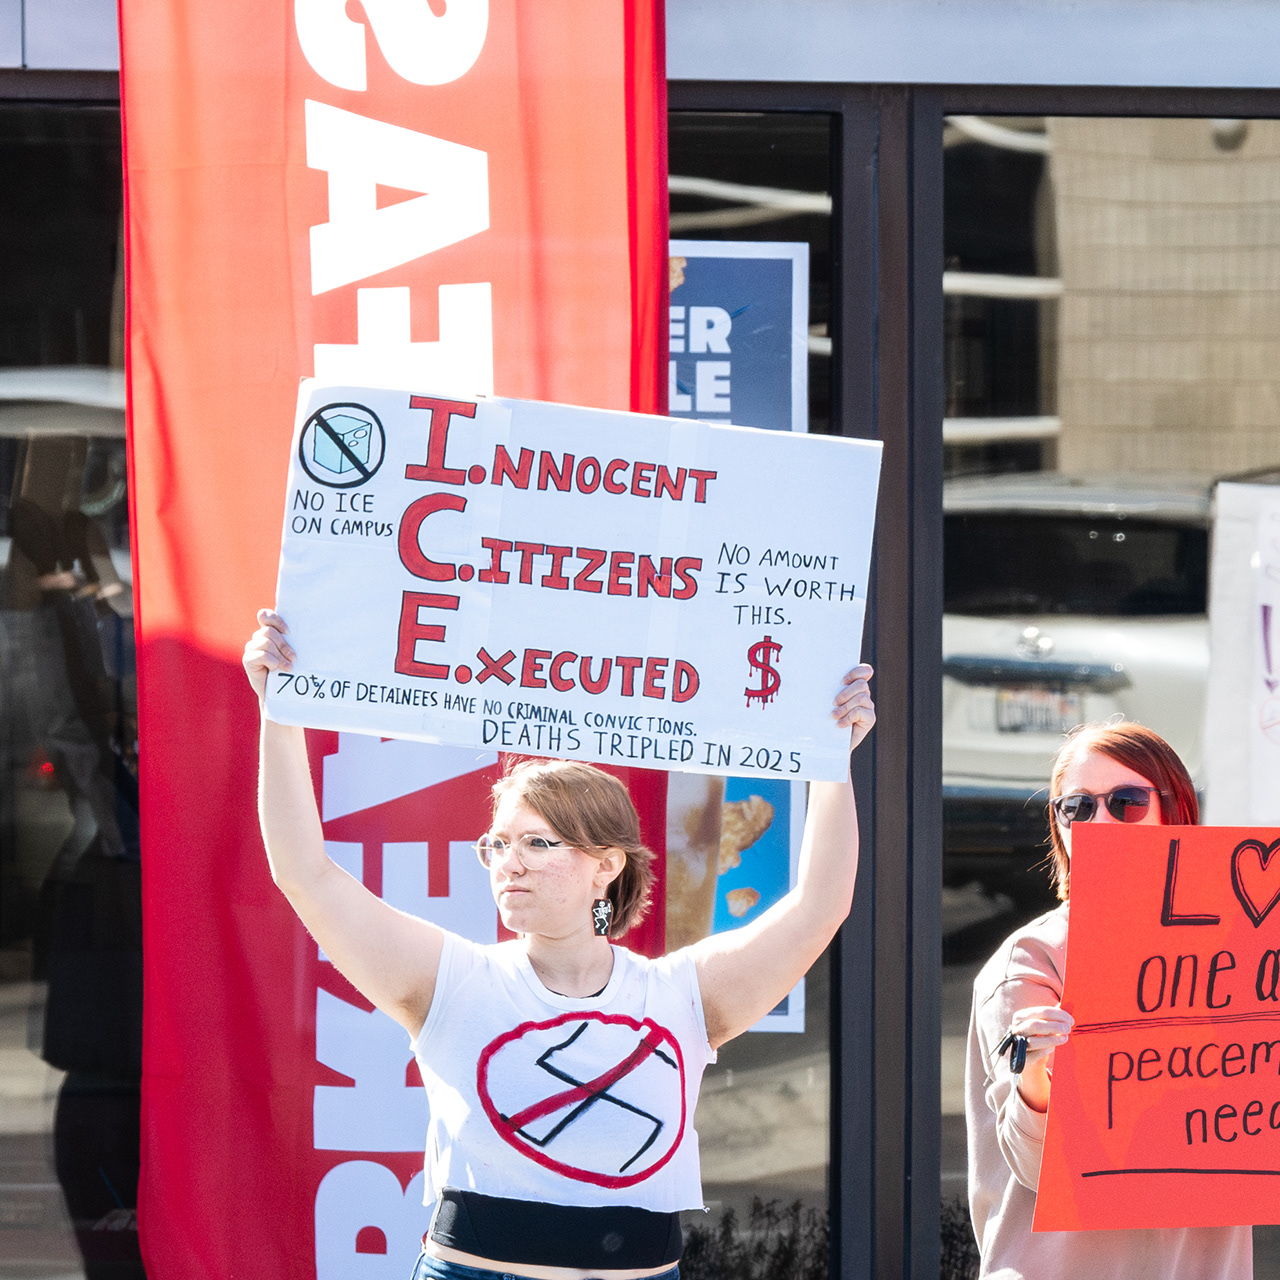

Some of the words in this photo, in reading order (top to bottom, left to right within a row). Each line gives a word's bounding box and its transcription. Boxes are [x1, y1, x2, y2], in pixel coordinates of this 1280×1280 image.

[293, 488, 325, 512] NO
[335, 492, 375, 513] ICE
[291, 515, 322, 534] ON
[330, 518, 394, 537] CAMPUS
[717, 542, 751, 565] NO
[758, 548, 839, 570] AMOUNT
[715, 572, 748, 594] IS
[764, 576, 856, 602] WORTH
[733, 605, 792, 625] THIS.
[330, 679, 352, 699] OF
[356, 682, 438, 707] DETAINEES
[443, 692, 478, 714] HAVE
[483, 698, 503, 715] NO
[507, 701, 577, 726] CRIMINAL
[584, 711, 698, 737] CONVICTIONS.
[482, 719, 581, 751] DEATHS
[593, 731, 695, 762] TRIPLED
[700, 742, 731, 766] IN
[739, 746, 802, 773] 2025
[1137, 949, 1237, 1013] one
